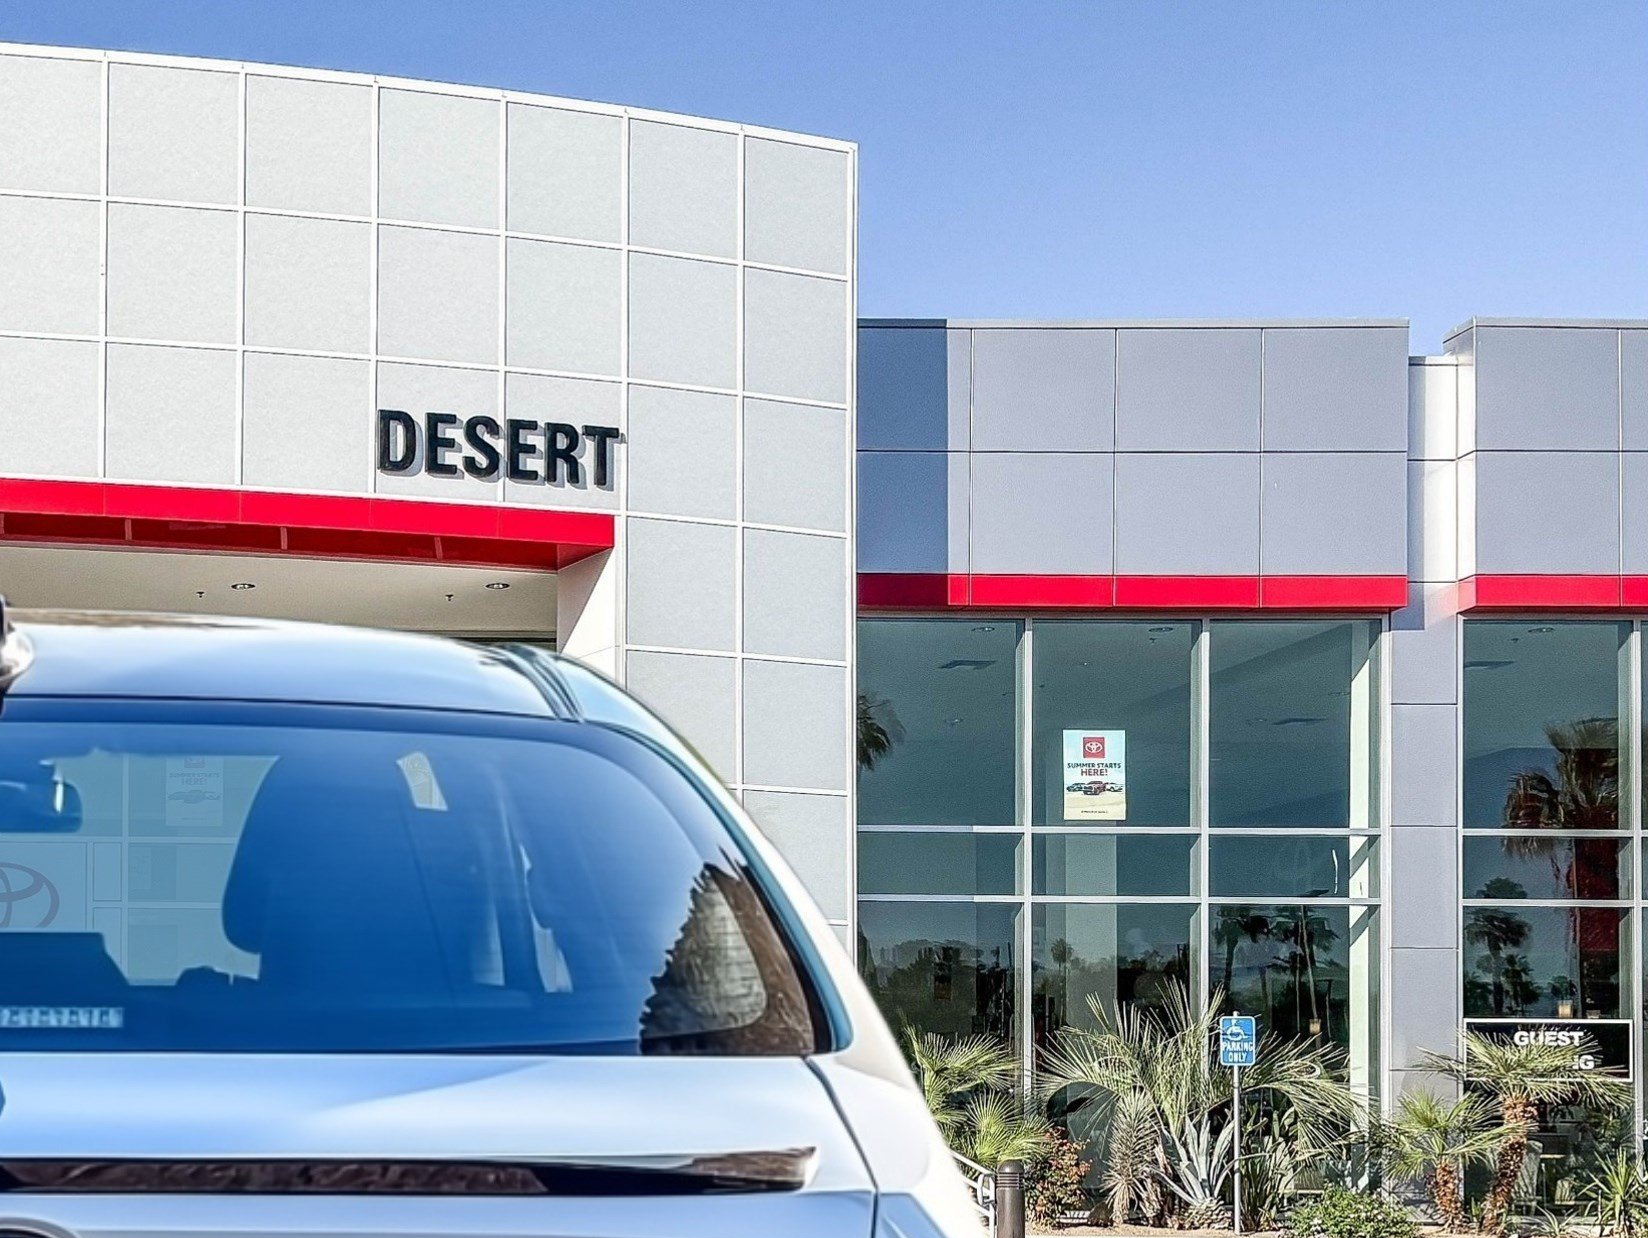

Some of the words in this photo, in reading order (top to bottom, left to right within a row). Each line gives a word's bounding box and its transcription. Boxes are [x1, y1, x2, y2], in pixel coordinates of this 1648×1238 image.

[377, 409, 621, 487] DESERT
[1513, 1031, 1585, 1047] GUEST
[1222, 1041, 1254, 1052] PARKING
[1228, 1052, 1248, 1062] ONLY
